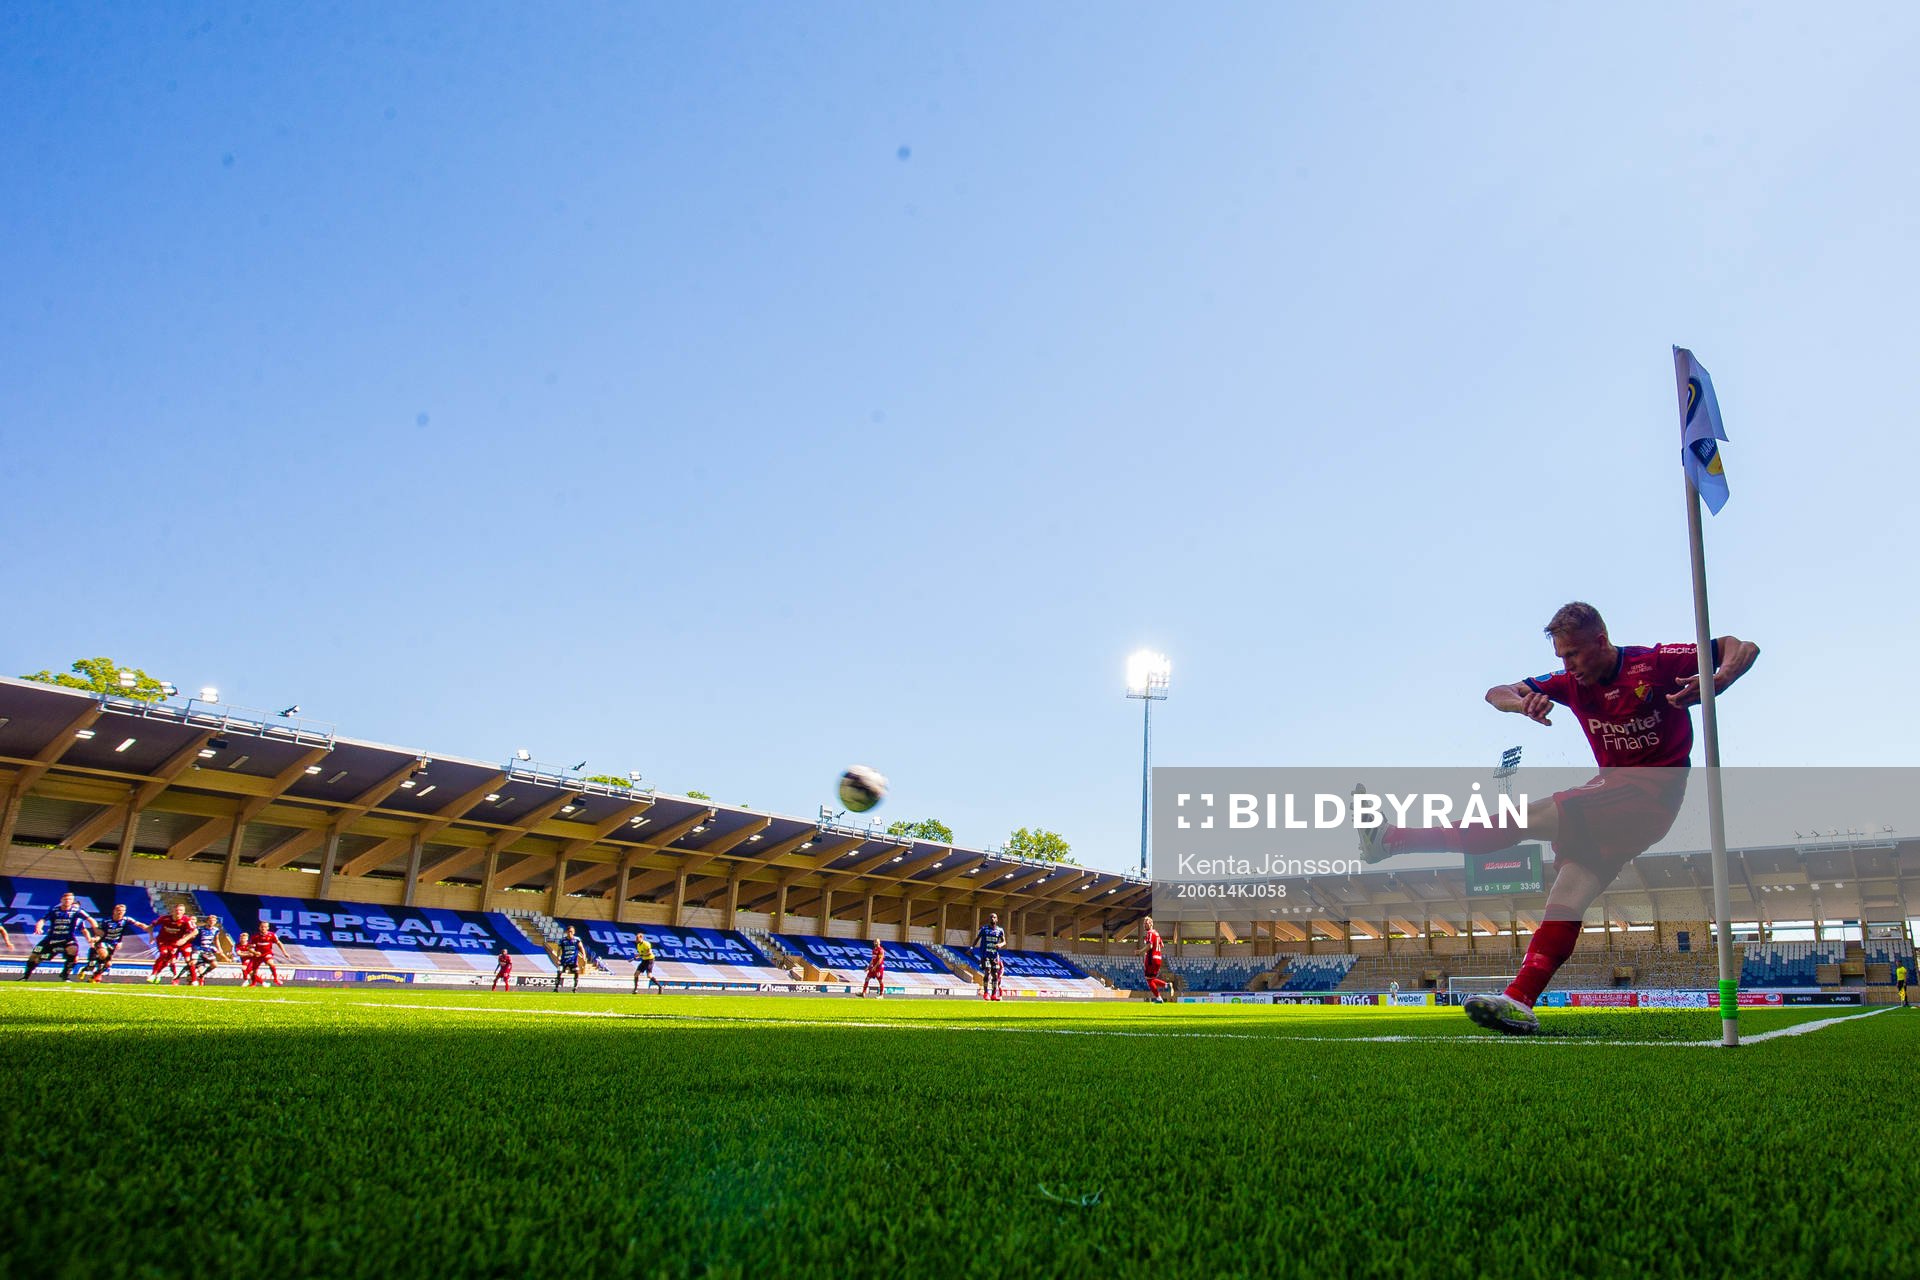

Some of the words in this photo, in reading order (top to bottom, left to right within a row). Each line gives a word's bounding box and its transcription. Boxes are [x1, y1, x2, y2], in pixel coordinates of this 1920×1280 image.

[1588, 709, 1662, 735] Prioritet
[1602, 732, 1660, 750] Finans
[258, 908, 490, 937] UPPSALA
[275, 925, 322, 941] ÄR
[525, 977, 556, 985] NORDIC
[1340, 995, 1370, 1006] BYGG
[1397, 995, 1422, 1003] weber
